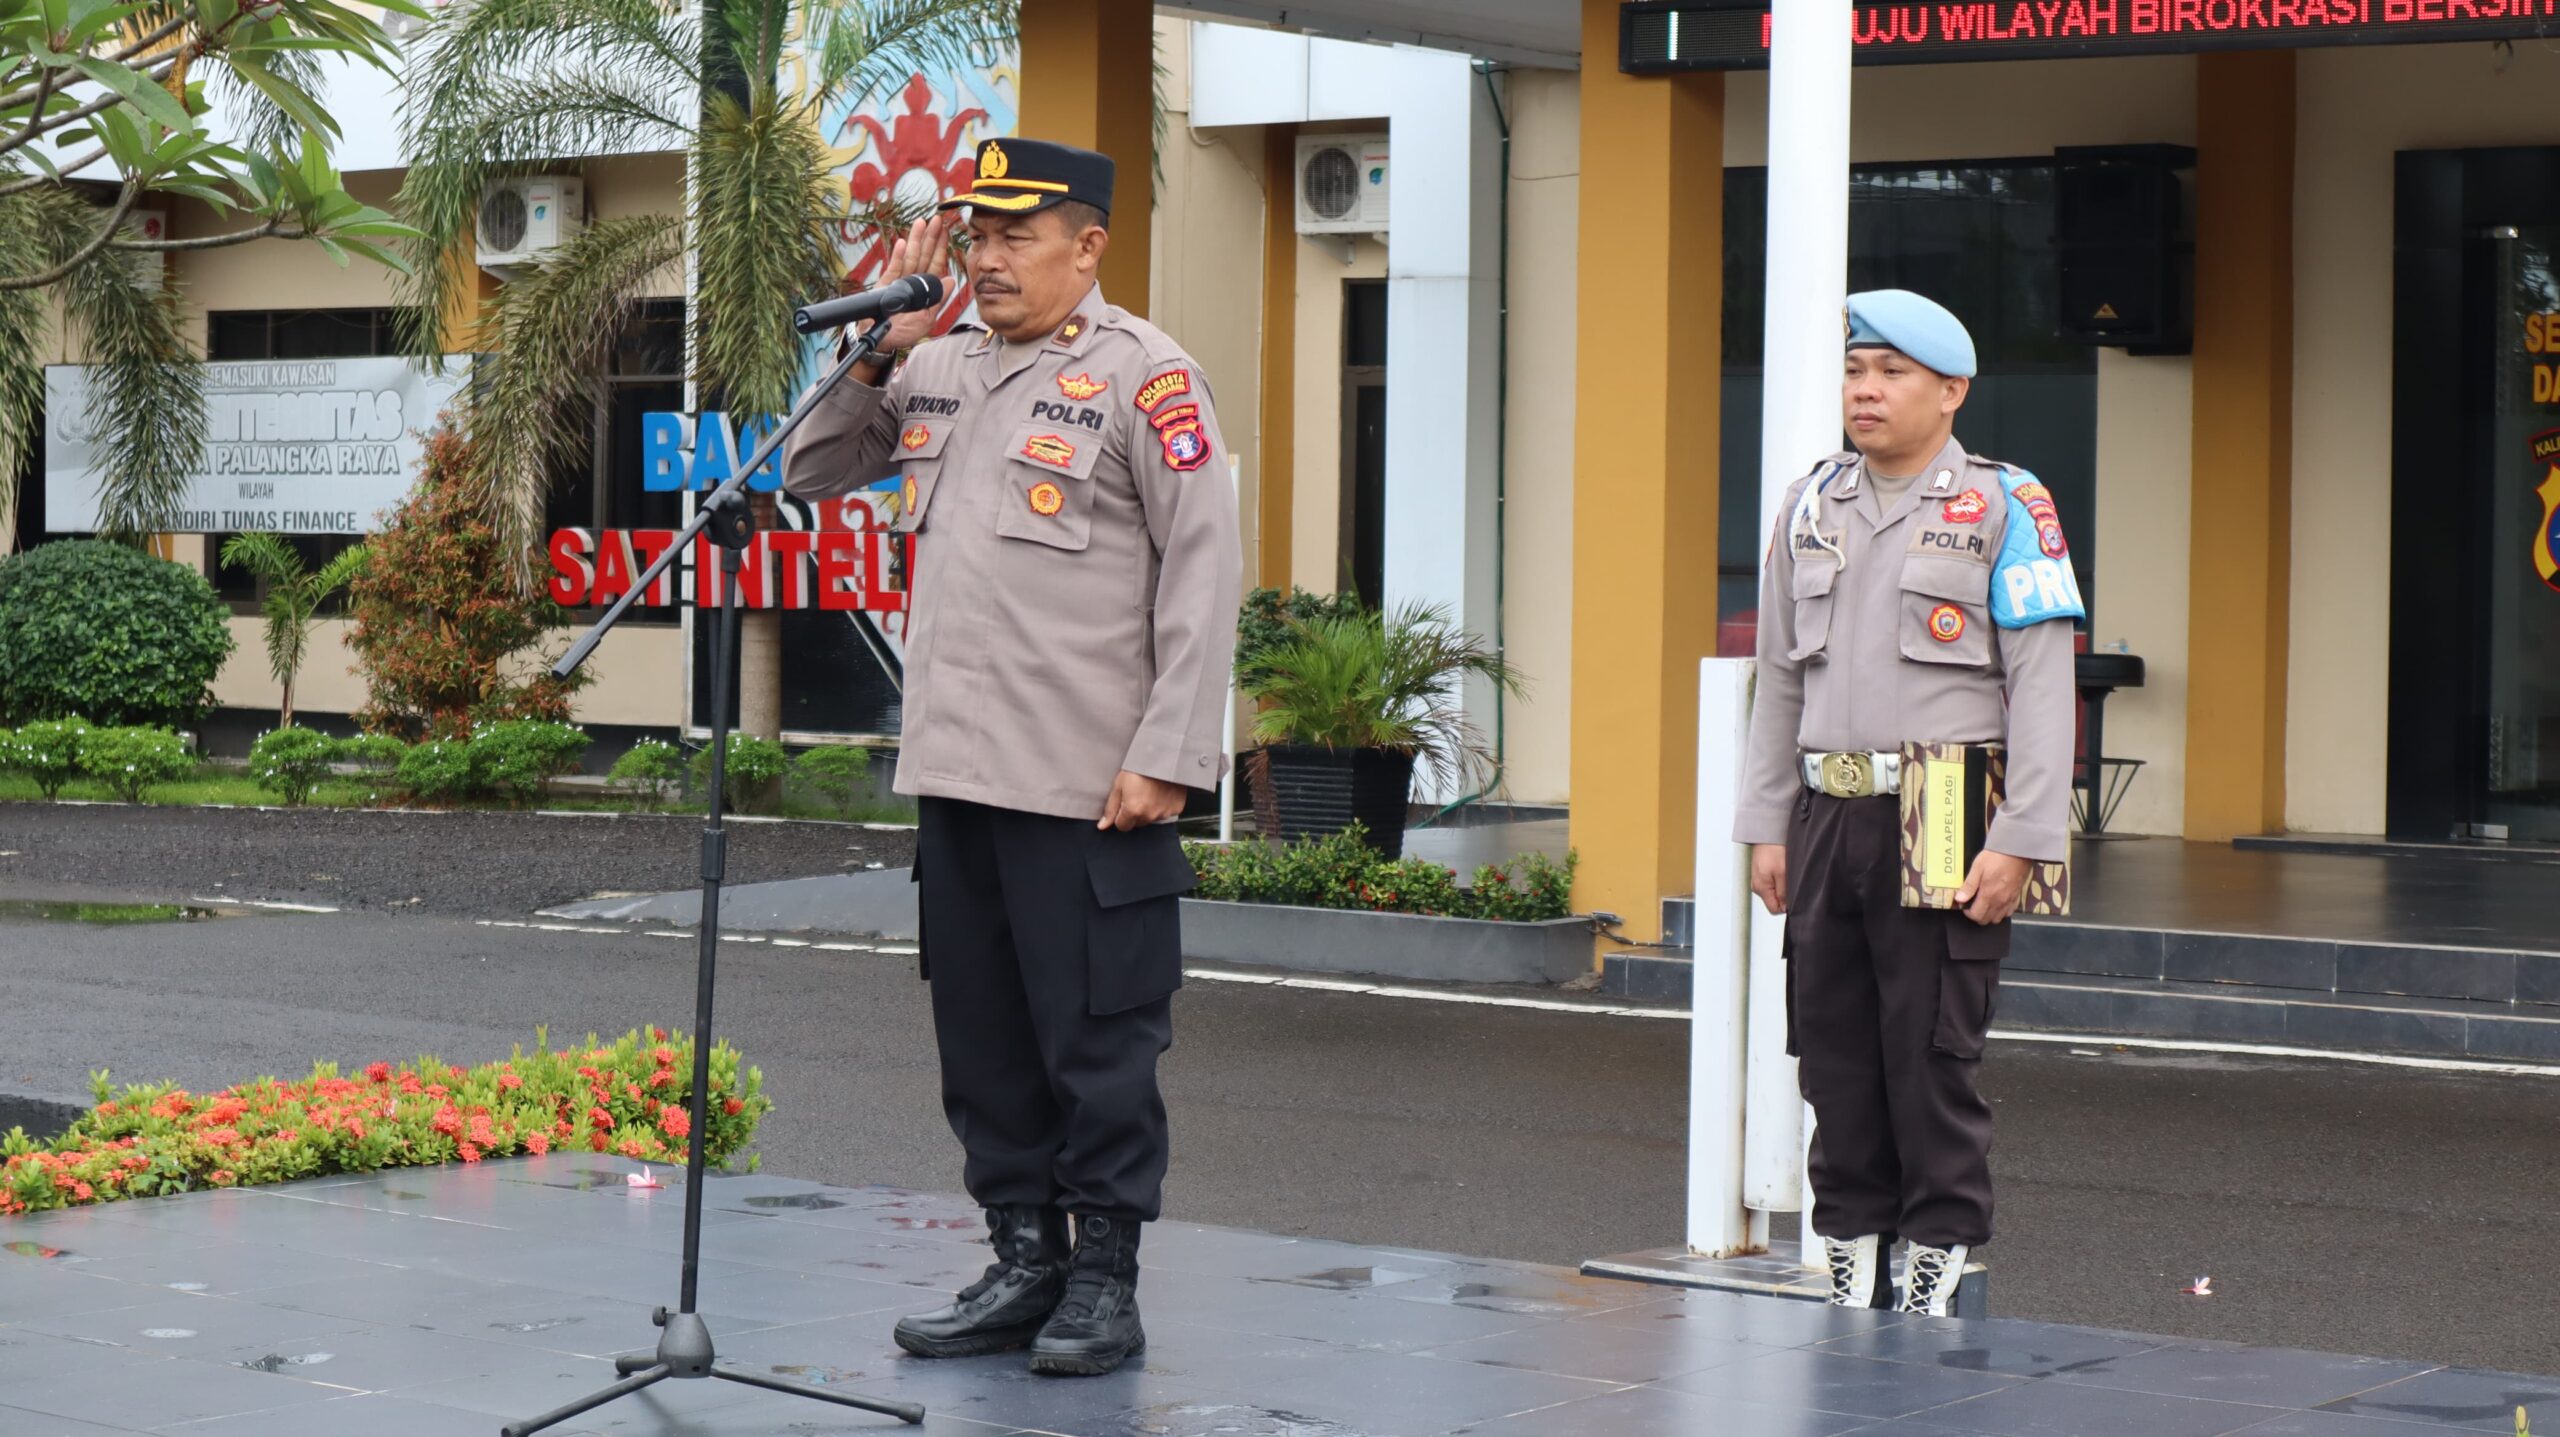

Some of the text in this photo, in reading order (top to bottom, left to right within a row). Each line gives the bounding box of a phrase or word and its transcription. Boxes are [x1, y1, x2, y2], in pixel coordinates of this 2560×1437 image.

[1938, 0, 2117, 40] WILAYAH
[2131, 0, 2368, 33] BIROKRASI
[271, 363, 335, 386] KAWASAN
[1138, 373, 1185, 405] POLRESTA
[906, 395, 960, 416] SUYATNO
[1032, 400, 1104, 431] POLRI
[216, 445, 331, 475] PALANGKA
[337, 445, 401, 475] RAYA
[238, 482, 274, 500] WILAYAH
[222, 510, 278, 531] TUNAS
[283, 511, 357, 531] FINANCE
[1922, 531, 1984, 555] POLRI
[549, 528, 680, 608] SAT
[1944, 775, 1954, 874] DOA APEL PAGI
